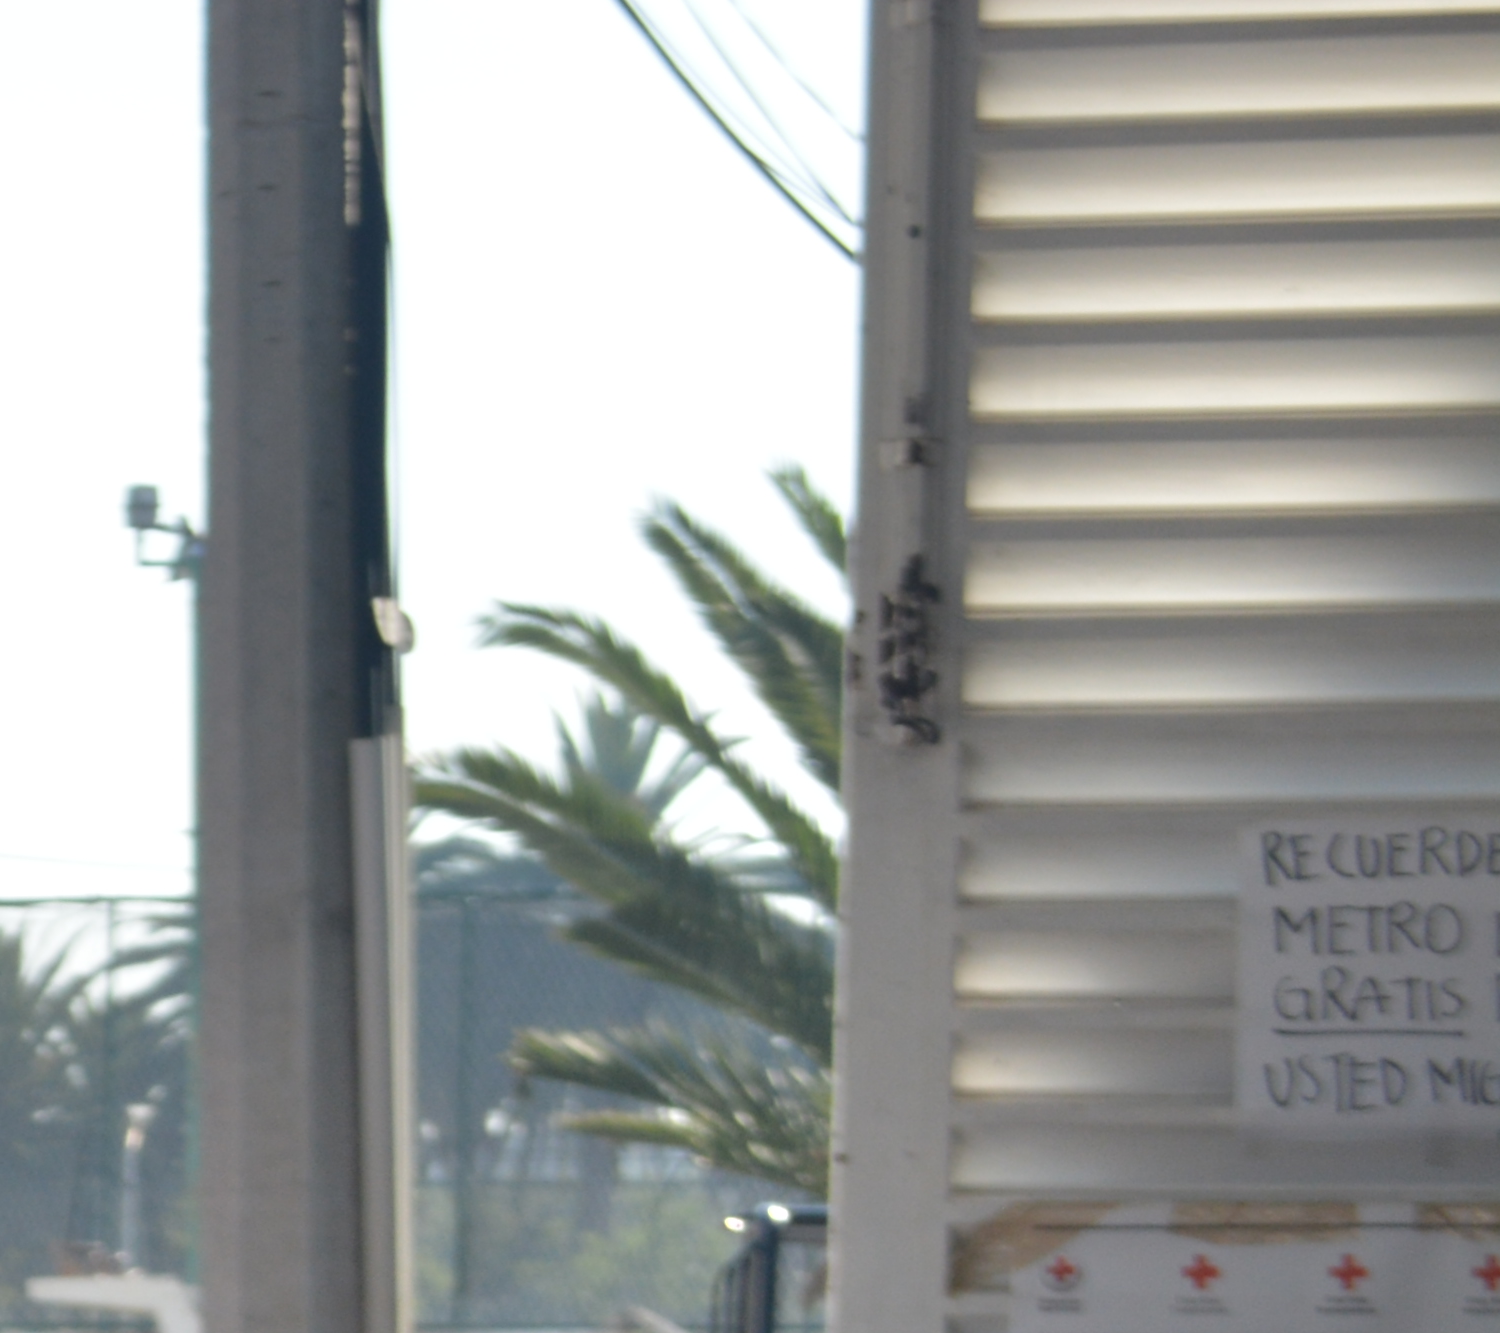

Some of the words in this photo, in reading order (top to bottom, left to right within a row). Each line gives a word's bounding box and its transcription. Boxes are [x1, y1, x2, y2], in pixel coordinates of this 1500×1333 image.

[1273, 900, 1464, 956] METRO
[1273, 965, 1468, 1022] GRATIS
[1263, 1053, 1408, 1112] USTED
